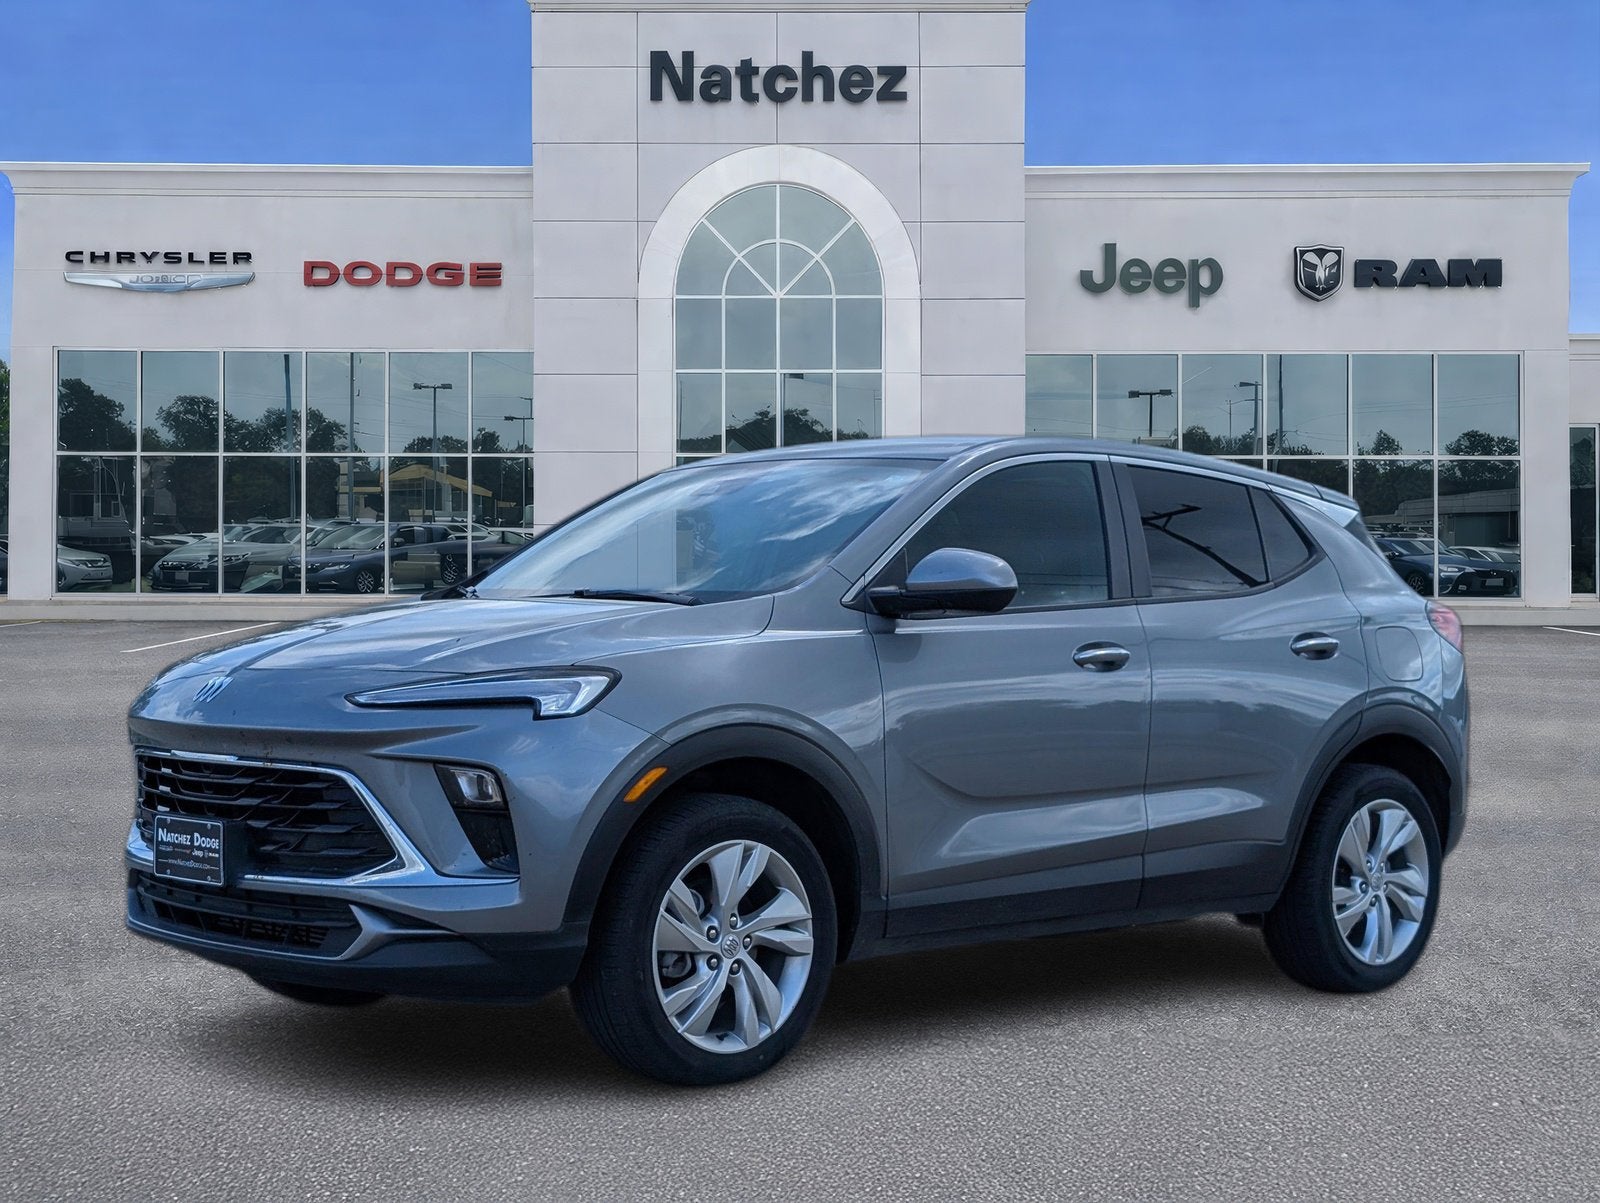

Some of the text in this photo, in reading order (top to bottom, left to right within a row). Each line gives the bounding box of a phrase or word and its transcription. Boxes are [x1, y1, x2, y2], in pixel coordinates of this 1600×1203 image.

[650, 50, 908, 103] Natchez
[65, 251, 253, 265] CHRYSLER
[303, 260, 503, 288] DODGE
[1080, 243, 1223, 308] Jeep
[1353, 258, 1503, 288] RAM
[158, 828, 191, 845] NATCHEZ
[193, 832, 219, 849] DODGE
